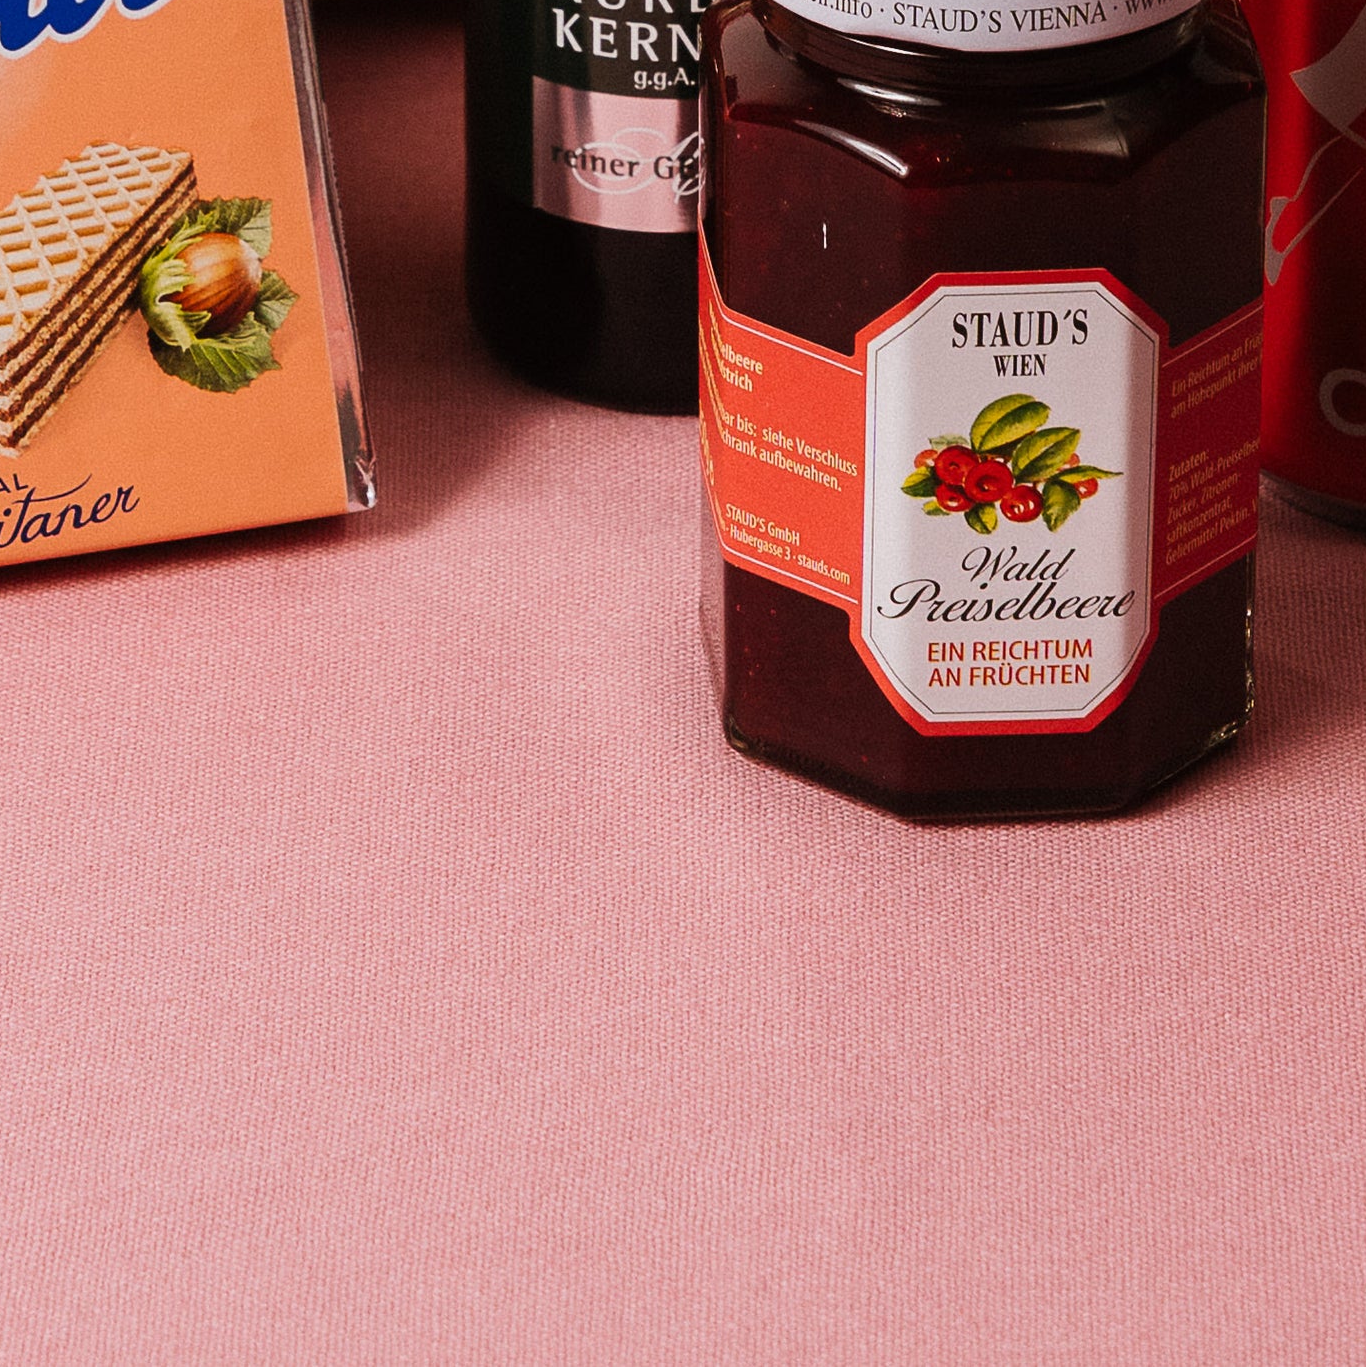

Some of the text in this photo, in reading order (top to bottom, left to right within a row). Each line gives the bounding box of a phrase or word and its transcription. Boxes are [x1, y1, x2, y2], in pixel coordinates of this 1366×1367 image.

[552, 8, 701, 63] KERN
[1010, 2, 1109, 33] VIENNA
[633, 67, 697, 91] g.g.A.
[550, 140, 640, 181] reiner
[993, 353, 1048, 378] WIEN
[736, 419, 758, 438] bis:
[762, 427, 794, 453] siehe
[795, 436, 859, 477] Verschluss
[1168, 448, 1210, 483] Zutaten:
[759, 447, 843, 493] aufbewahren.
[729, 524, 852, 586] Hubergasse 3 stauds.com
[767, 525, 801, 547] GmbH
[960, 544, 1077, 586] Wald
[875, 577, 1137, 624] Preiselbeere
[927, 638, 1094, 663] EIN REICHTUM
[928, 661, 1092, 688] AN FRÜCHTEN
